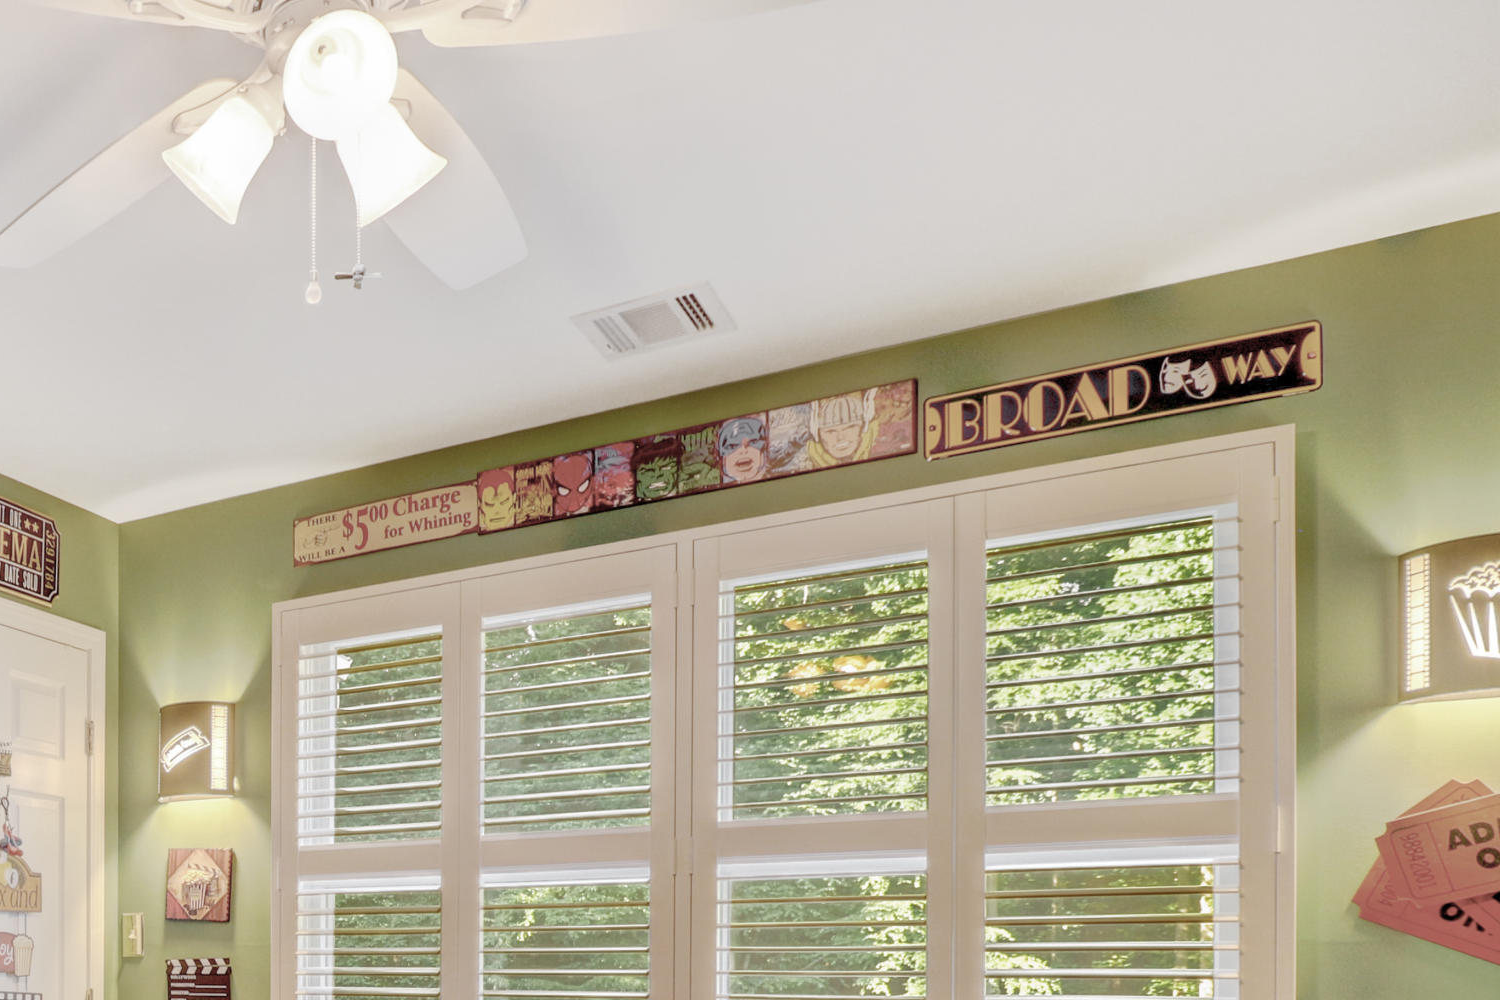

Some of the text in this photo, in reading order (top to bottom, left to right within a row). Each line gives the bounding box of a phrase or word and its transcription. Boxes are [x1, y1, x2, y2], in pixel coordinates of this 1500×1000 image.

[945, 344, 1297, 449] BROAD WAY
[392, 489, 461, 516] Charge
[9, 508, 23, 530] ONE
[306, 513, 339, 528] THERE
[384, 511, 473, 540] for Whining
[298, 545, 347, 563] WILL BE A
[4, 563, 21, 586] DATE
[22, 570, 39, 593] SOLD
[1448, 816, 1500, 850] AD
[10, 885, 39, 910] and
